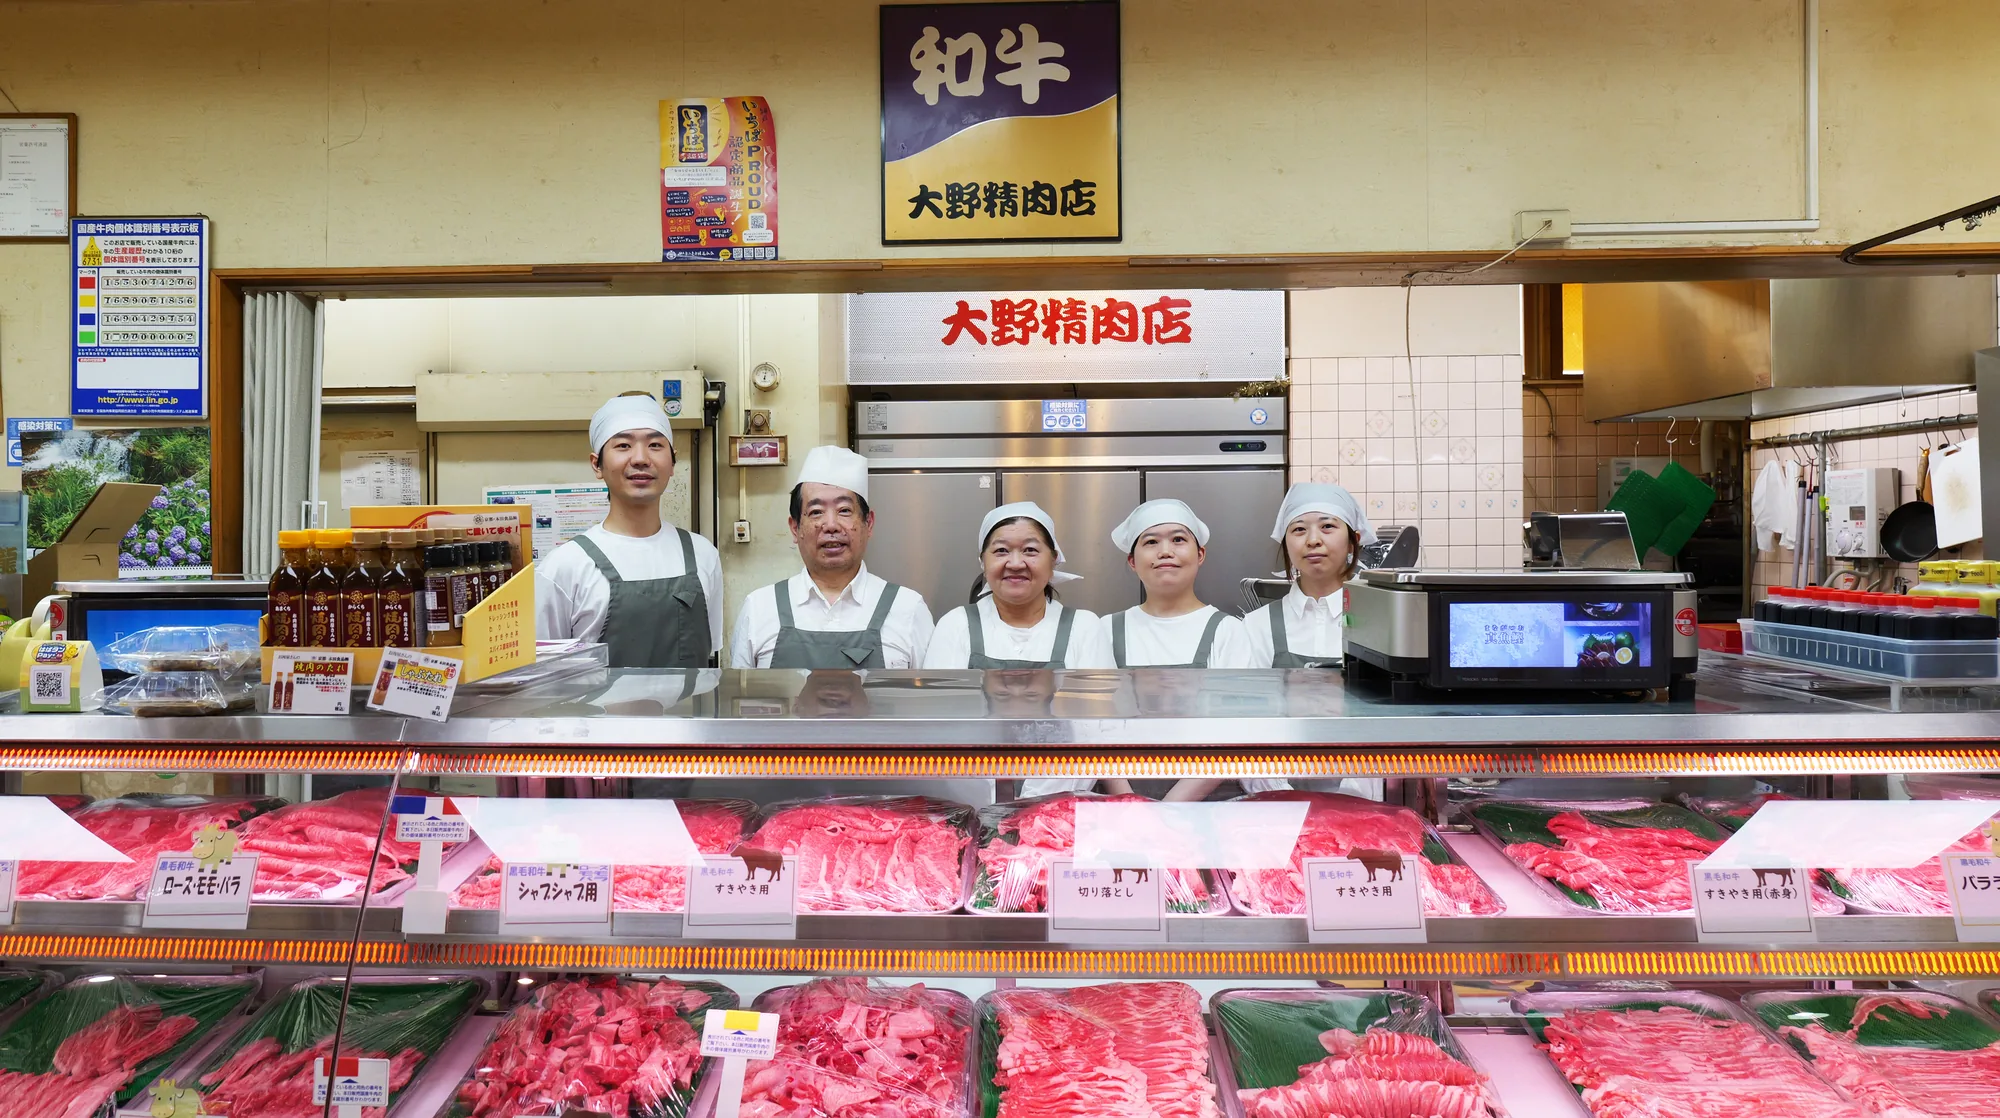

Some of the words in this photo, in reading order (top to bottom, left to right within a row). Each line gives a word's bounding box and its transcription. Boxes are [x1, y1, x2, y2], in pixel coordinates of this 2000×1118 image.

[909, 23, 1071, 106] 和牛
[907, 179, 1097, 220] 大野精肉店
[77, 223, 199, 234] 国産牛肉個体識別番号表示板
[941, 296, 1192, 346] 大野精肉店
[97, 396, 179, 404] http://www.lin.go.jp
[18, 421, 62, 431] 感染対策に
[294, 663, 345, 673] 焼肉のたれ
[400, 666, 444, 684] しゃぶたれ
[159, 861, 194, 871] 黒毛和牛
[1960, 858, 1992, 866] 黒毛和牛
[509, 866, 546, 877] 黒毛和牛
[701, 867, 734, 876] 黒毛和牛
[1063, 870, 1097, 879] 黒毛和牛
[1318, 869, 1354, 880] 黒毛和牛
[1704, 872, 1740, 881] 黒毛和牛
[518, 881, 598, 902] シャブシャブ用
[715, 884, 769, 895] すきやき用
[1078, 886, 1134, 898] 切り落とし
[1336, 885, 1393, 897] すきやき用
[1705, 888, 1798, 900] すきやき用(赤身)
